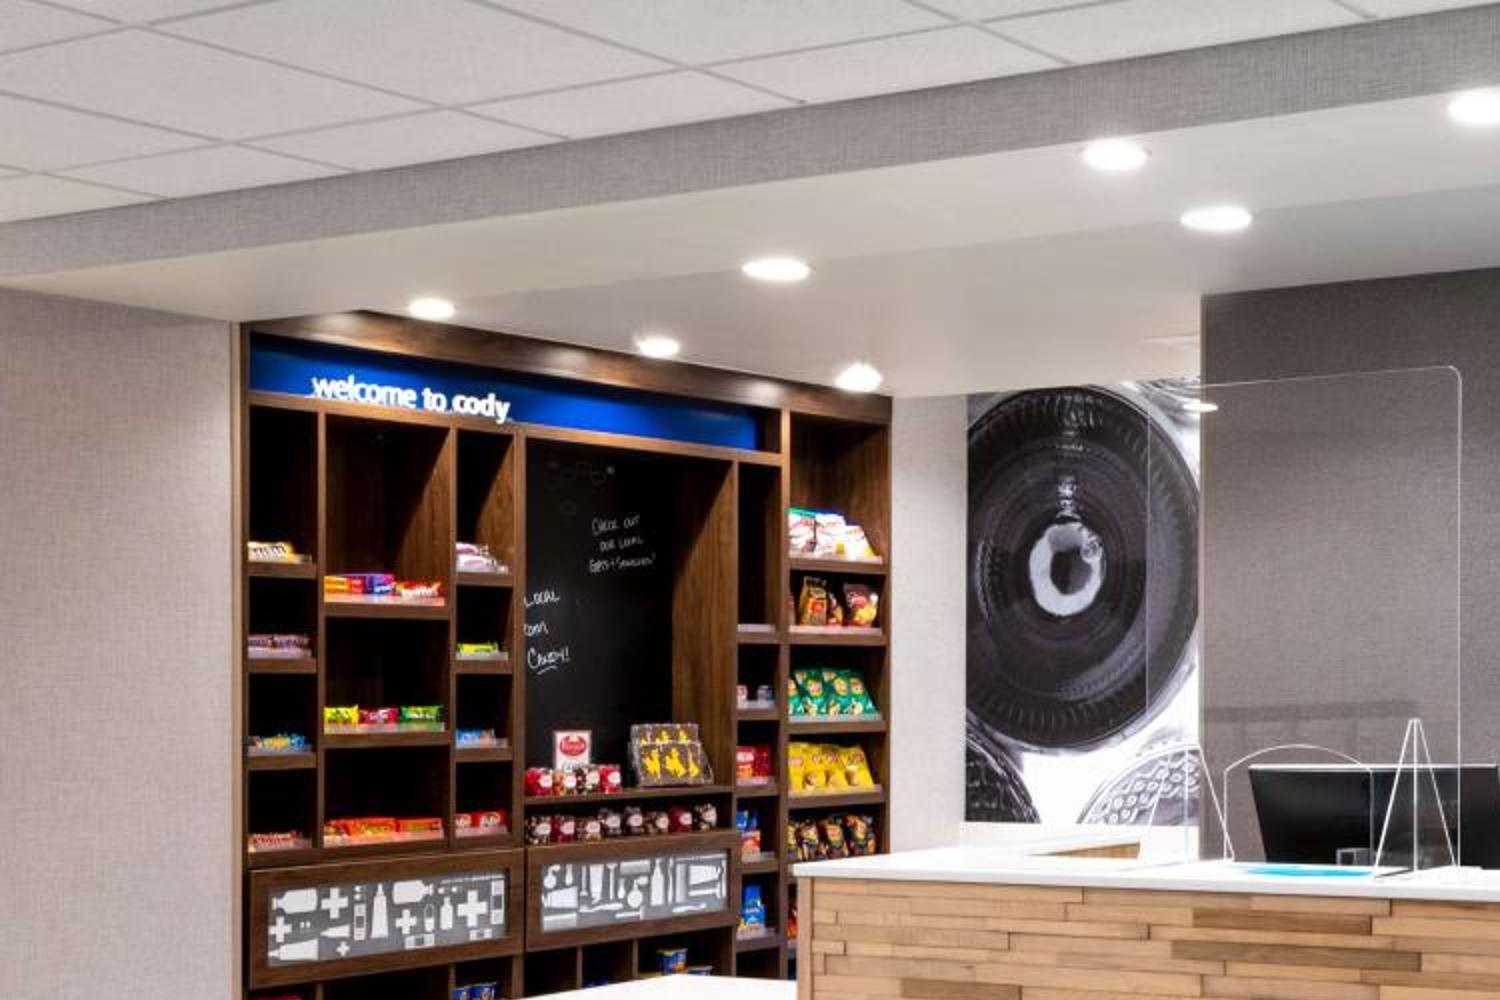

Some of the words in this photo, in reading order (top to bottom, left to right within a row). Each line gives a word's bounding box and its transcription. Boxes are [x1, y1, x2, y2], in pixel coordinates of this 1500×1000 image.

[312, 374, 417, 407] welcome
[421, 387, 447, 412] to
[451, 393, 510, 424] cody
